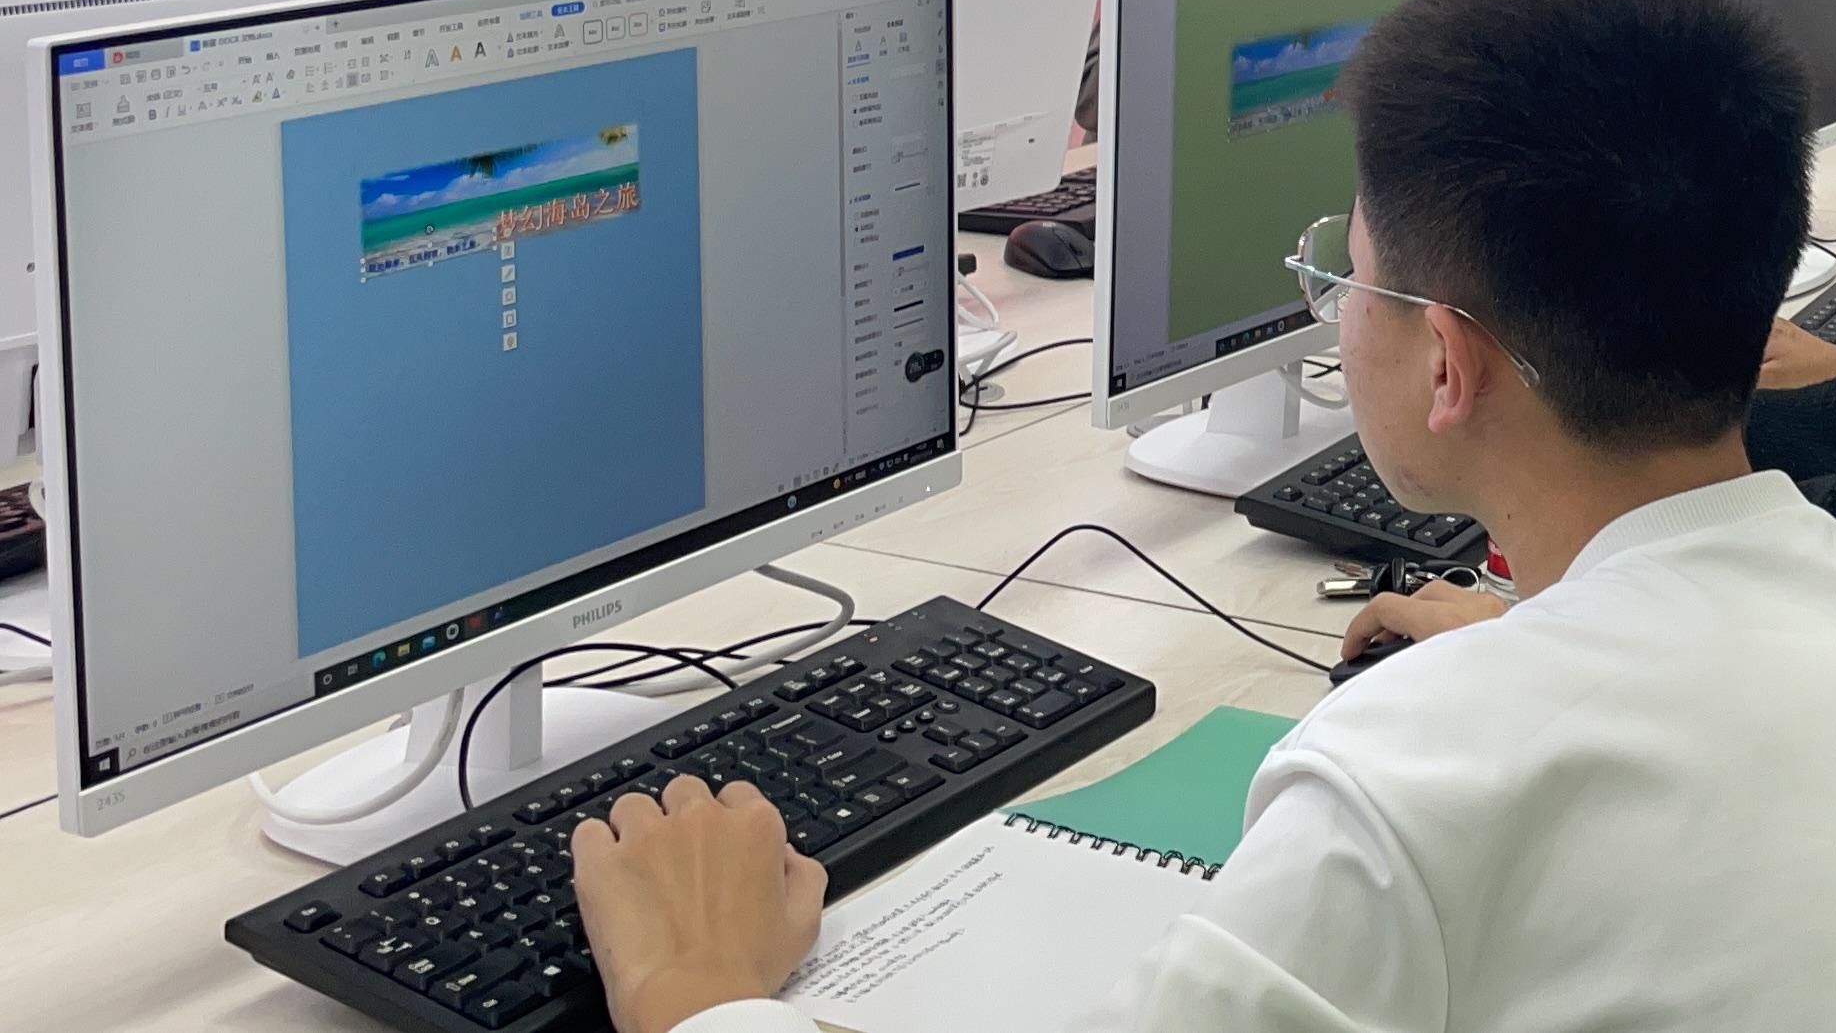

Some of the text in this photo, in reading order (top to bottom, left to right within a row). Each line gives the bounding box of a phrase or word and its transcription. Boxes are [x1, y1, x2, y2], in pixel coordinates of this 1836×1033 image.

[498, 181, 638, 239] 梦幻海岛之旅
[572, 599, 623, 629] PHILIPS
